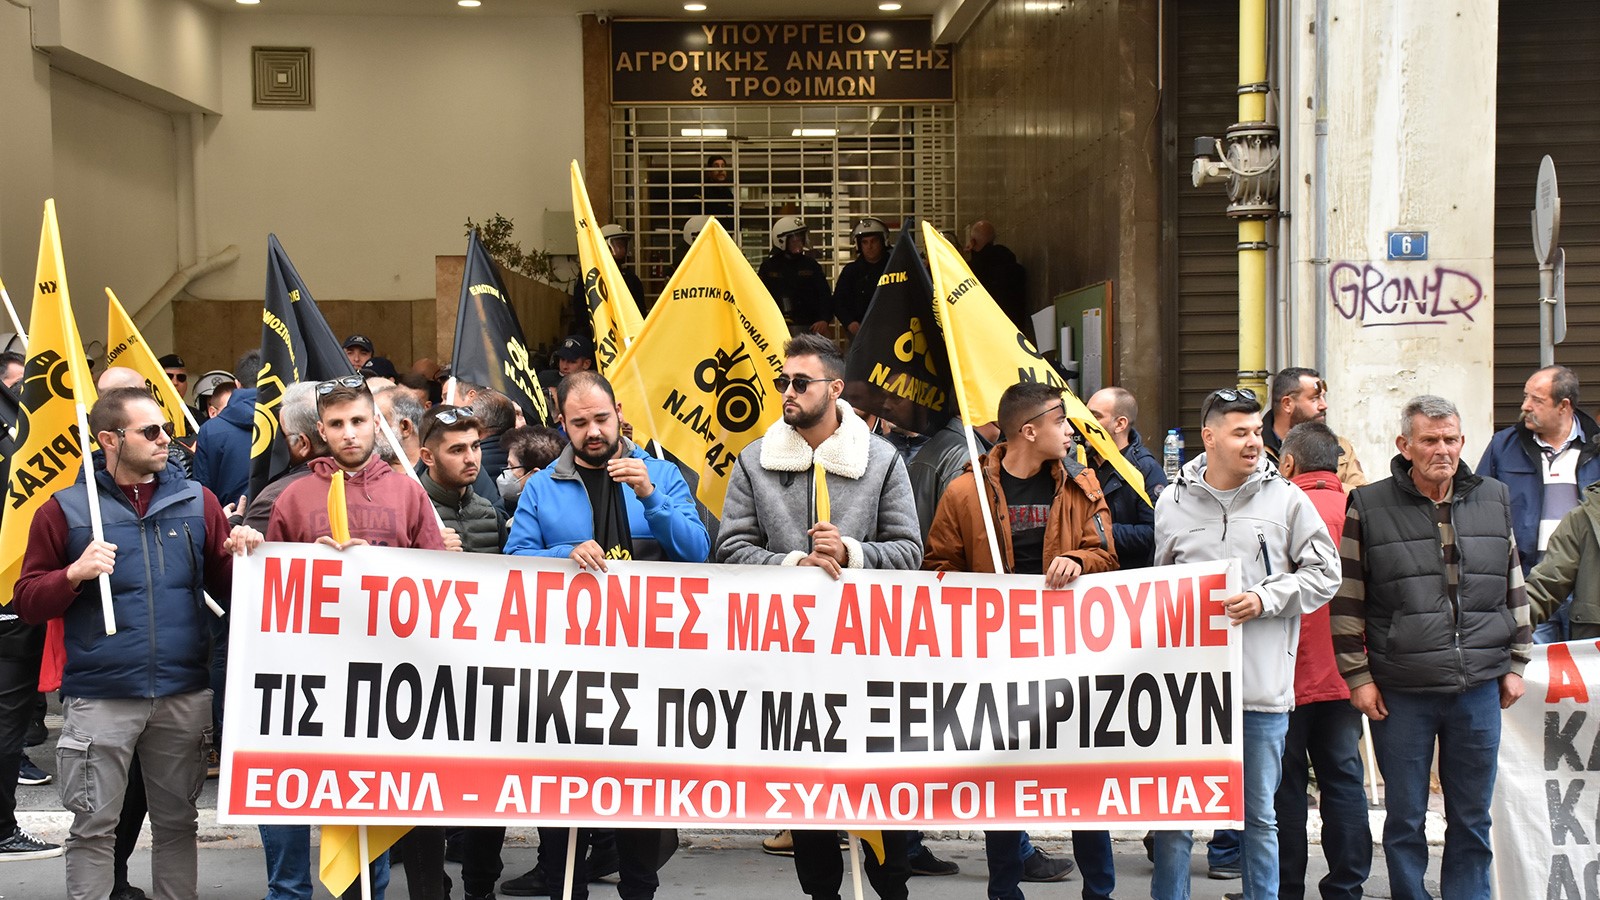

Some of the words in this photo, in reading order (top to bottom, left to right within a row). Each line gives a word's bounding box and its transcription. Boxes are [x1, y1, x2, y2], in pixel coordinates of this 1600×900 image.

[702, 24, 866, 45] ΥΠΟΥΡΓΕΙΟ
[616, 51, 768, 72] ΑΓΡΟΤΙΚΗΣ
[787, 50, 950, 71] ΑΝΑΠΤΥΞΗΣ
[691, 78, 707, 97] &
[726, 76, 876, 97] ΤΡΟΦΙΜΩΝ
[1402, 236, 1412, 254] 6
[260, 557, 342, 635] ΜΕ
[361, 575, 479, 640] ΤΟΥΣ
[727, 592, 815, 654] ΜΑΣ
[254, 673, 326, 736] ΤΙΣ
[343, 662, 639, 746] ΠΟΛΙΤΙΚΕΣ
[657, 687, 748, 750] ΠΟΥ
[761, 690, 848, 753] ΜΑΣ
[866, 671, 1233, 753] ΞΕΚΛΗΡΙΖΟΥΝ
[245, 767, 444, 812] ΕΟΑΣΝΛ
[495, 774, 746, 818] ΑΓΡΟΤΙΚΟΙ
[765, 779, 996, 821] ΣΥΛΛΟΓΟΙ
[1097, 775, 1231, 815] ΑΓΙΑΣ
